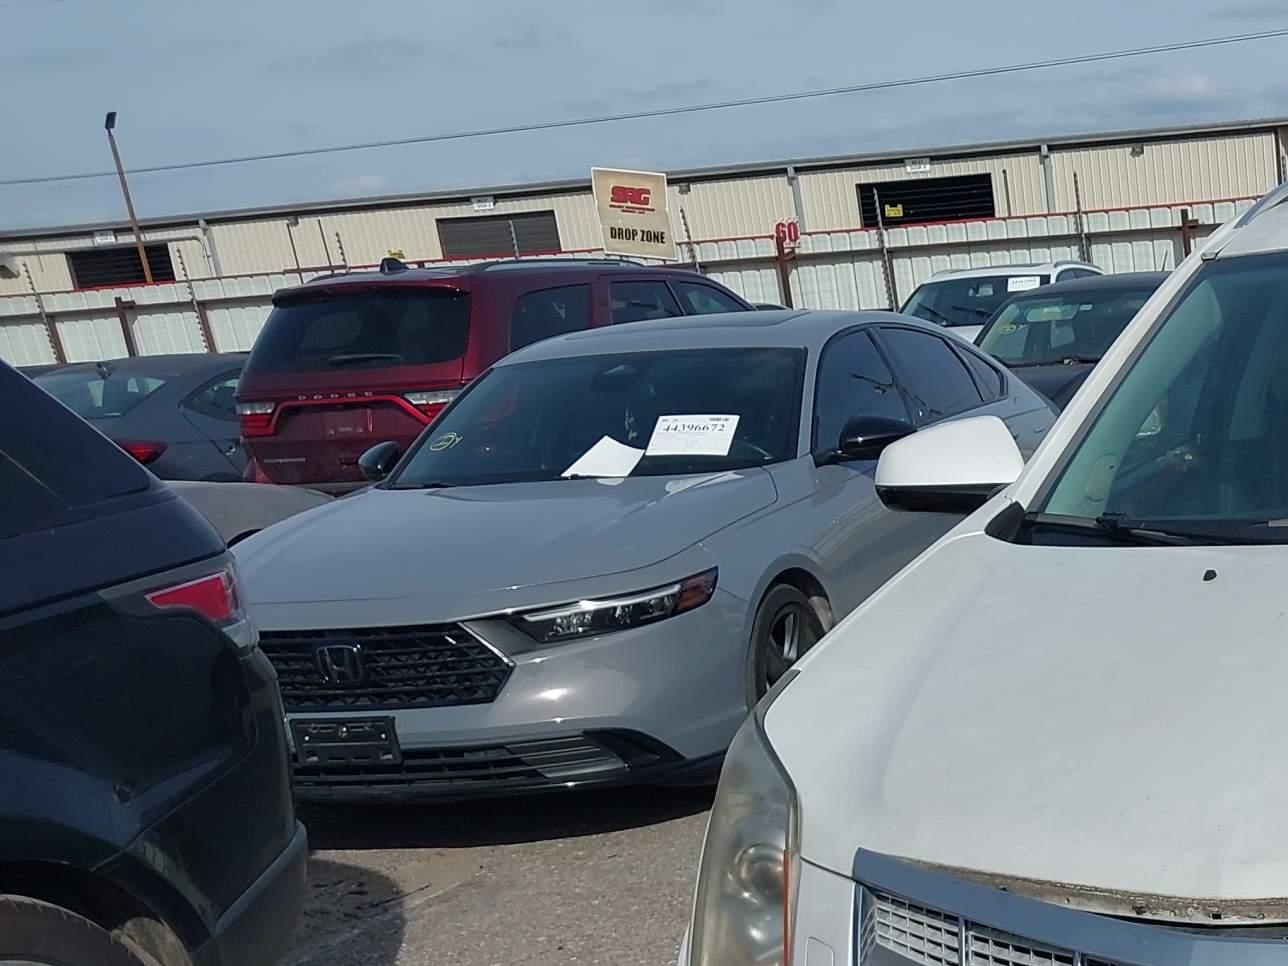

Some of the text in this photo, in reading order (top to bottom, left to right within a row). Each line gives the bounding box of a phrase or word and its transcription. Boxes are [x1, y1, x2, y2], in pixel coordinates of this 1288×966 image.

[609, 226, 666, 244] DROP ZONE
[775, 221, 799, 242] 60
[662, 423, 726, 433] 44396672
